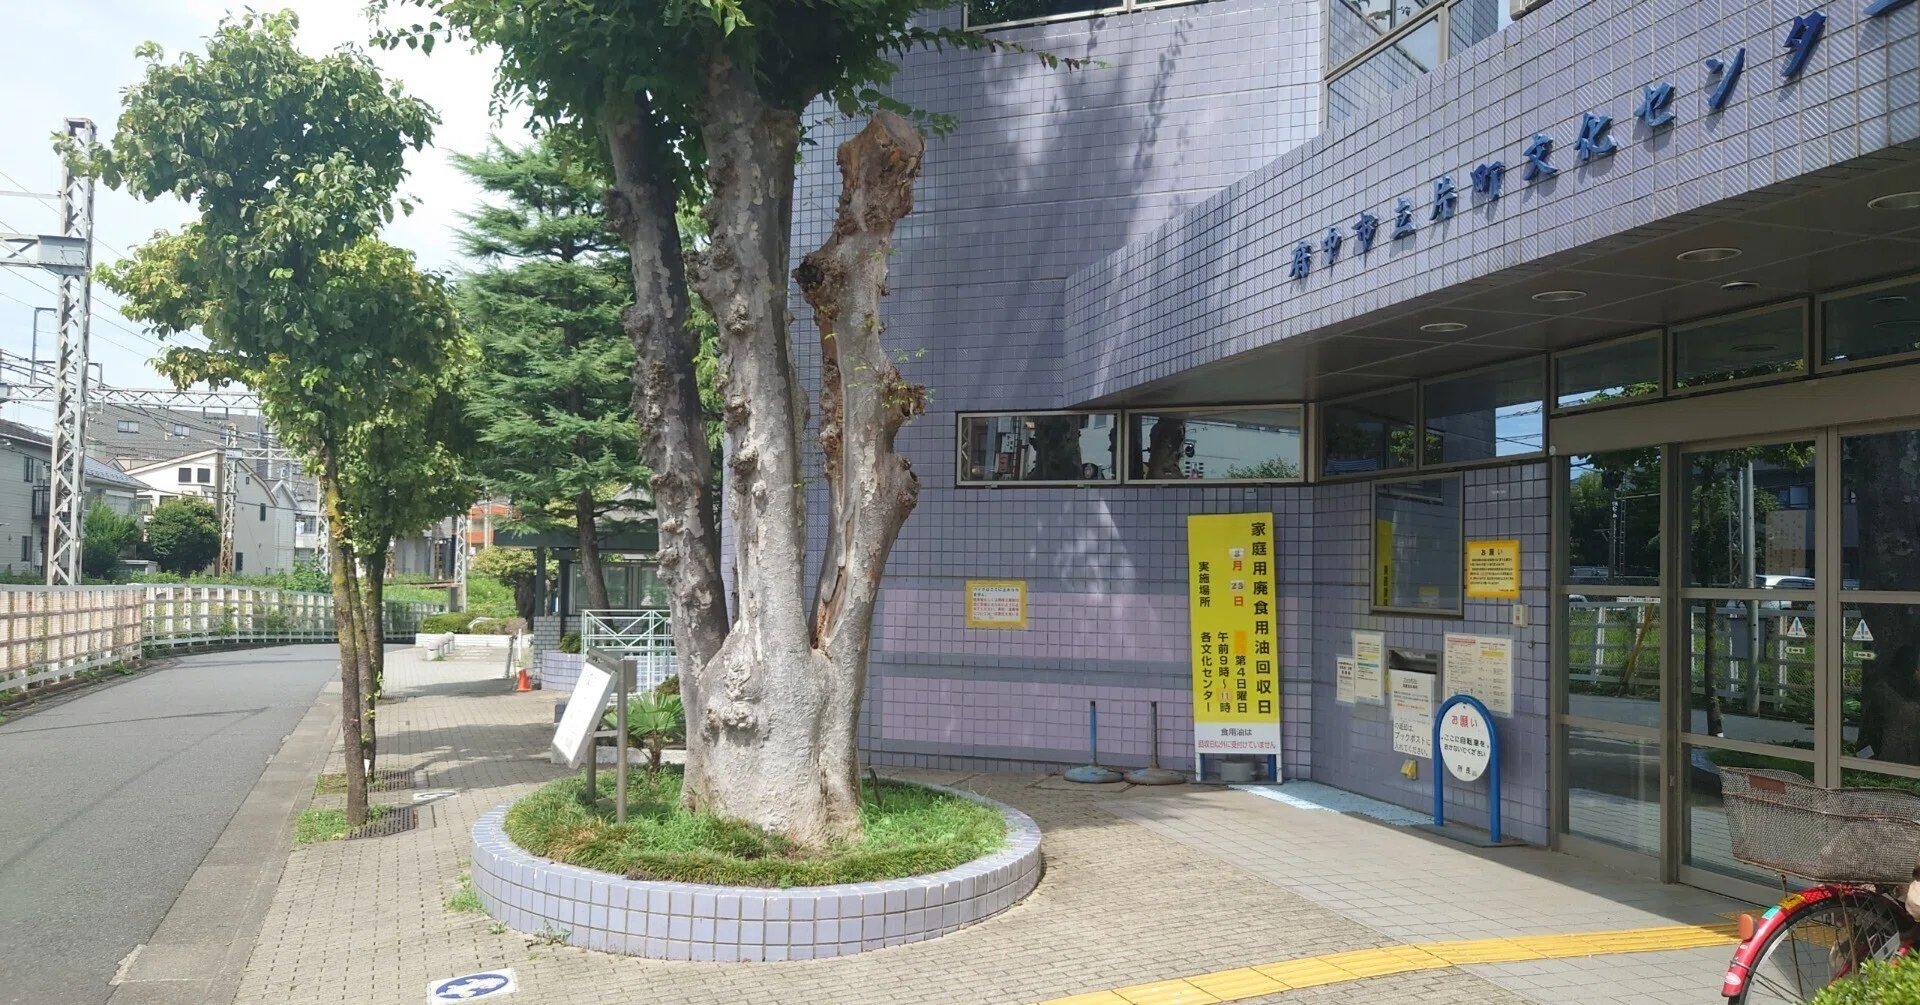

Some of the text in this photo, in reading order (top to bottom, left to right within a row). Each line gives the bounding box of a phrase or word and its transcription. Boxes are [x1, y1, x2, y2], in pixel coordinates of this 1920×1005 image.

[1250, 521, 1271, 715] 家庭用廃食用油回収日
[1198, 561, 1213, 712] 実施場所 各文化センター
[1235, 655, 1247, 713] 第4日曜日
[1451, 715, 1478, 728] お願い
[1221, 728, 1253, 737] 食用油は
[1394, 731, 1431, 747] ブックポストに
[1444, 734, 1486, 748] ここに自転車を
[1444, 743, 1486, 757] おかないでください
